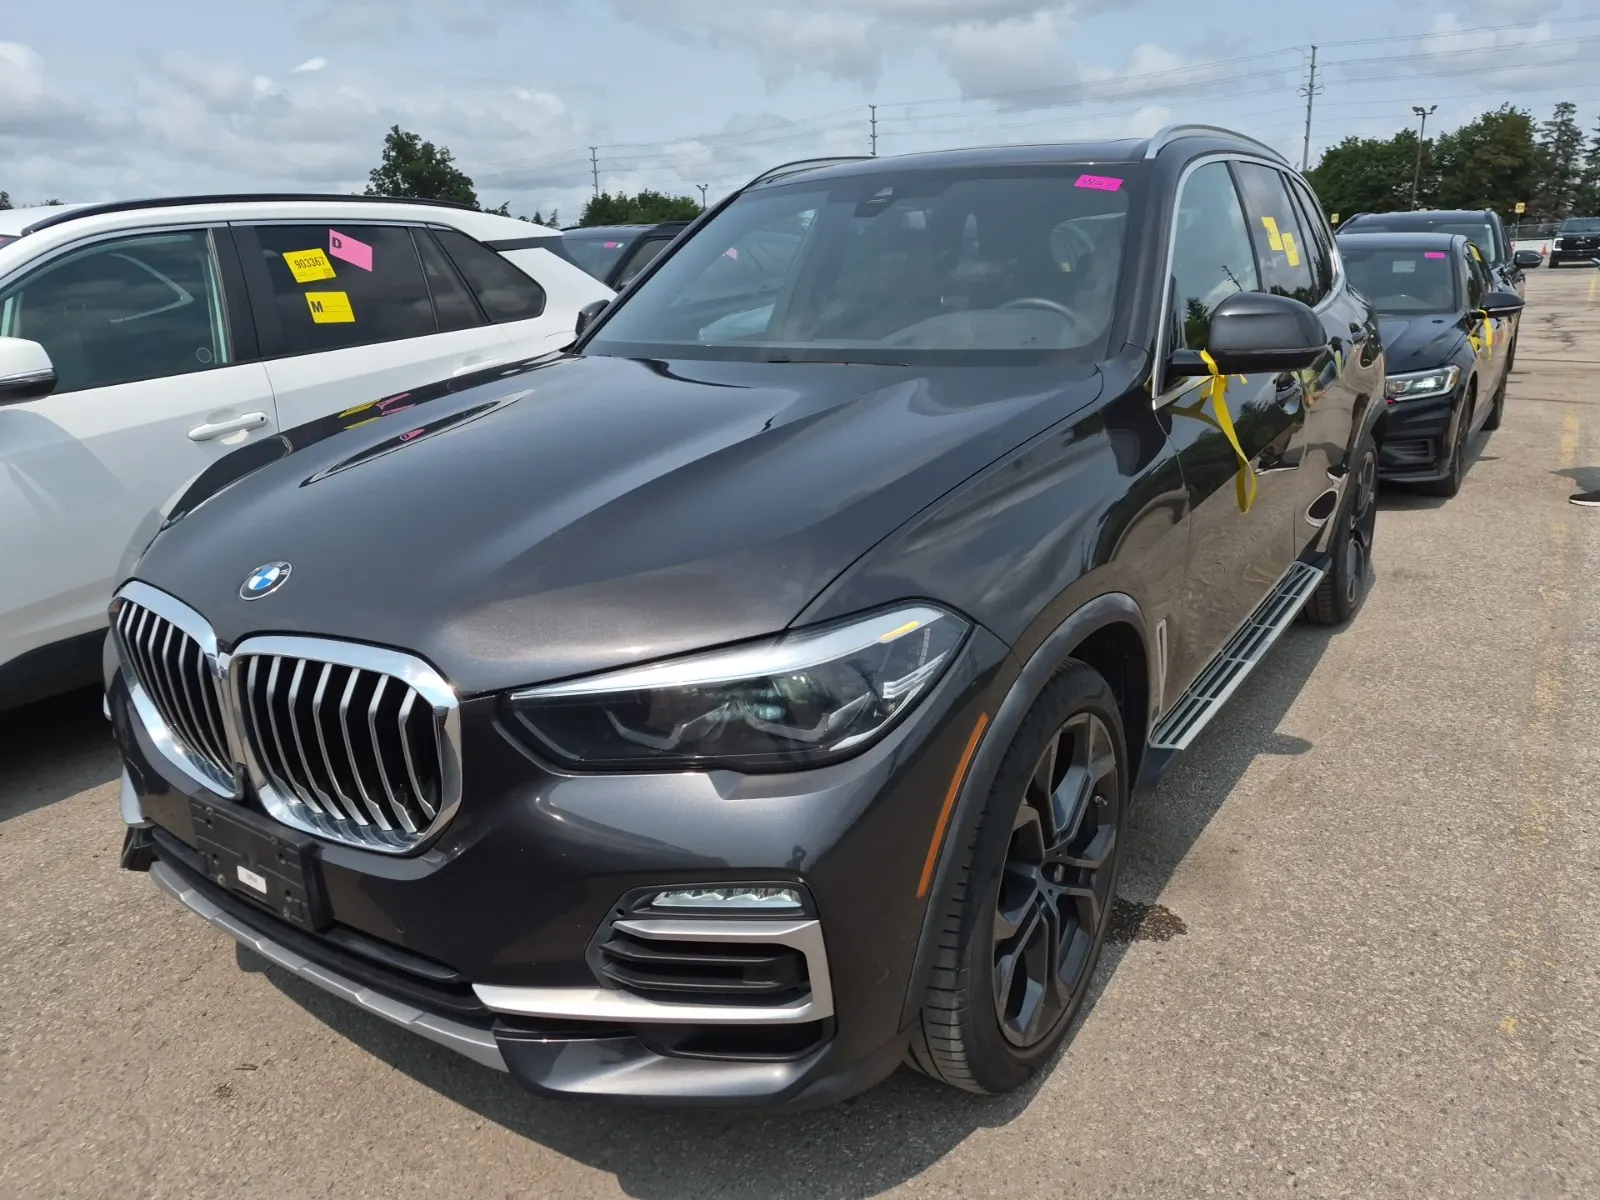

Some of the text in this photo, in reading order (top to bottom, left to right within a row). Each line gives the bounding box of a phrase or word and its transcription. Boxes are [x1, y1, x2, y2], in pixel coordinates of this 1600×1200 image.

[332, 237, 342, 249] D
[294, 257, 325, 269] 903367
[310, 301, 324, 313] M
